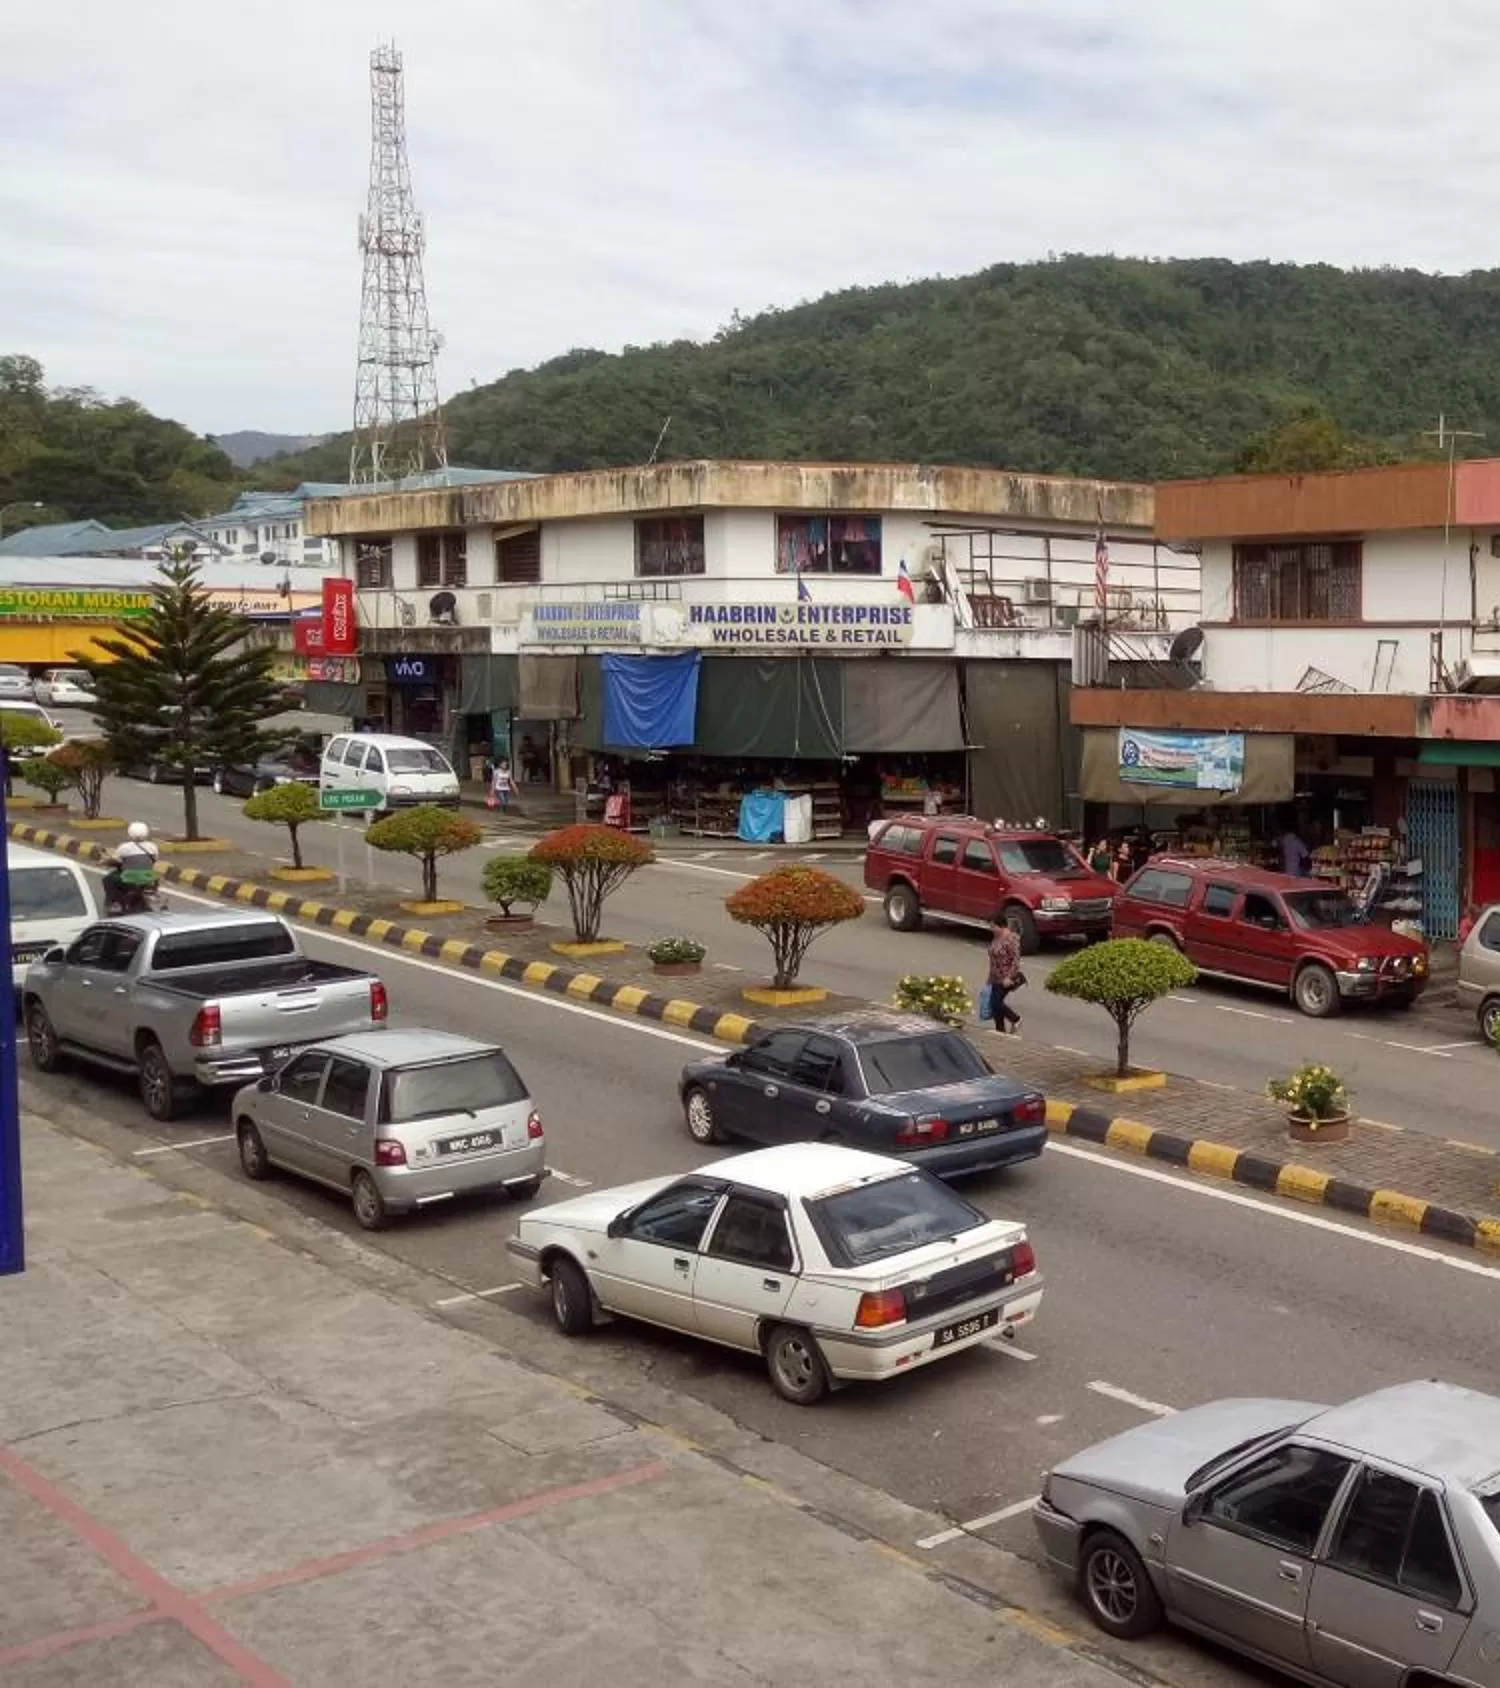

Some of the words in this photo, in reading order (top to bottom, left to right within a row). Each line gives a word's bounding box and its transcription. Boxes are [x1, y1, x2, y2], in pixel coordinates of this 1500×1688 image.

[83, 592, 153, 608] MUSLIM
[690, 606, 776, 624] HAABRIN
[798, 606, 912, 625] ENTERPRISE
[713, 628, 821, 642] WHOLESALE
[826, 629, 837, 642] &
[842, 629, 903, 642] RETAIL
[395, 658, 425, 676] vivo
